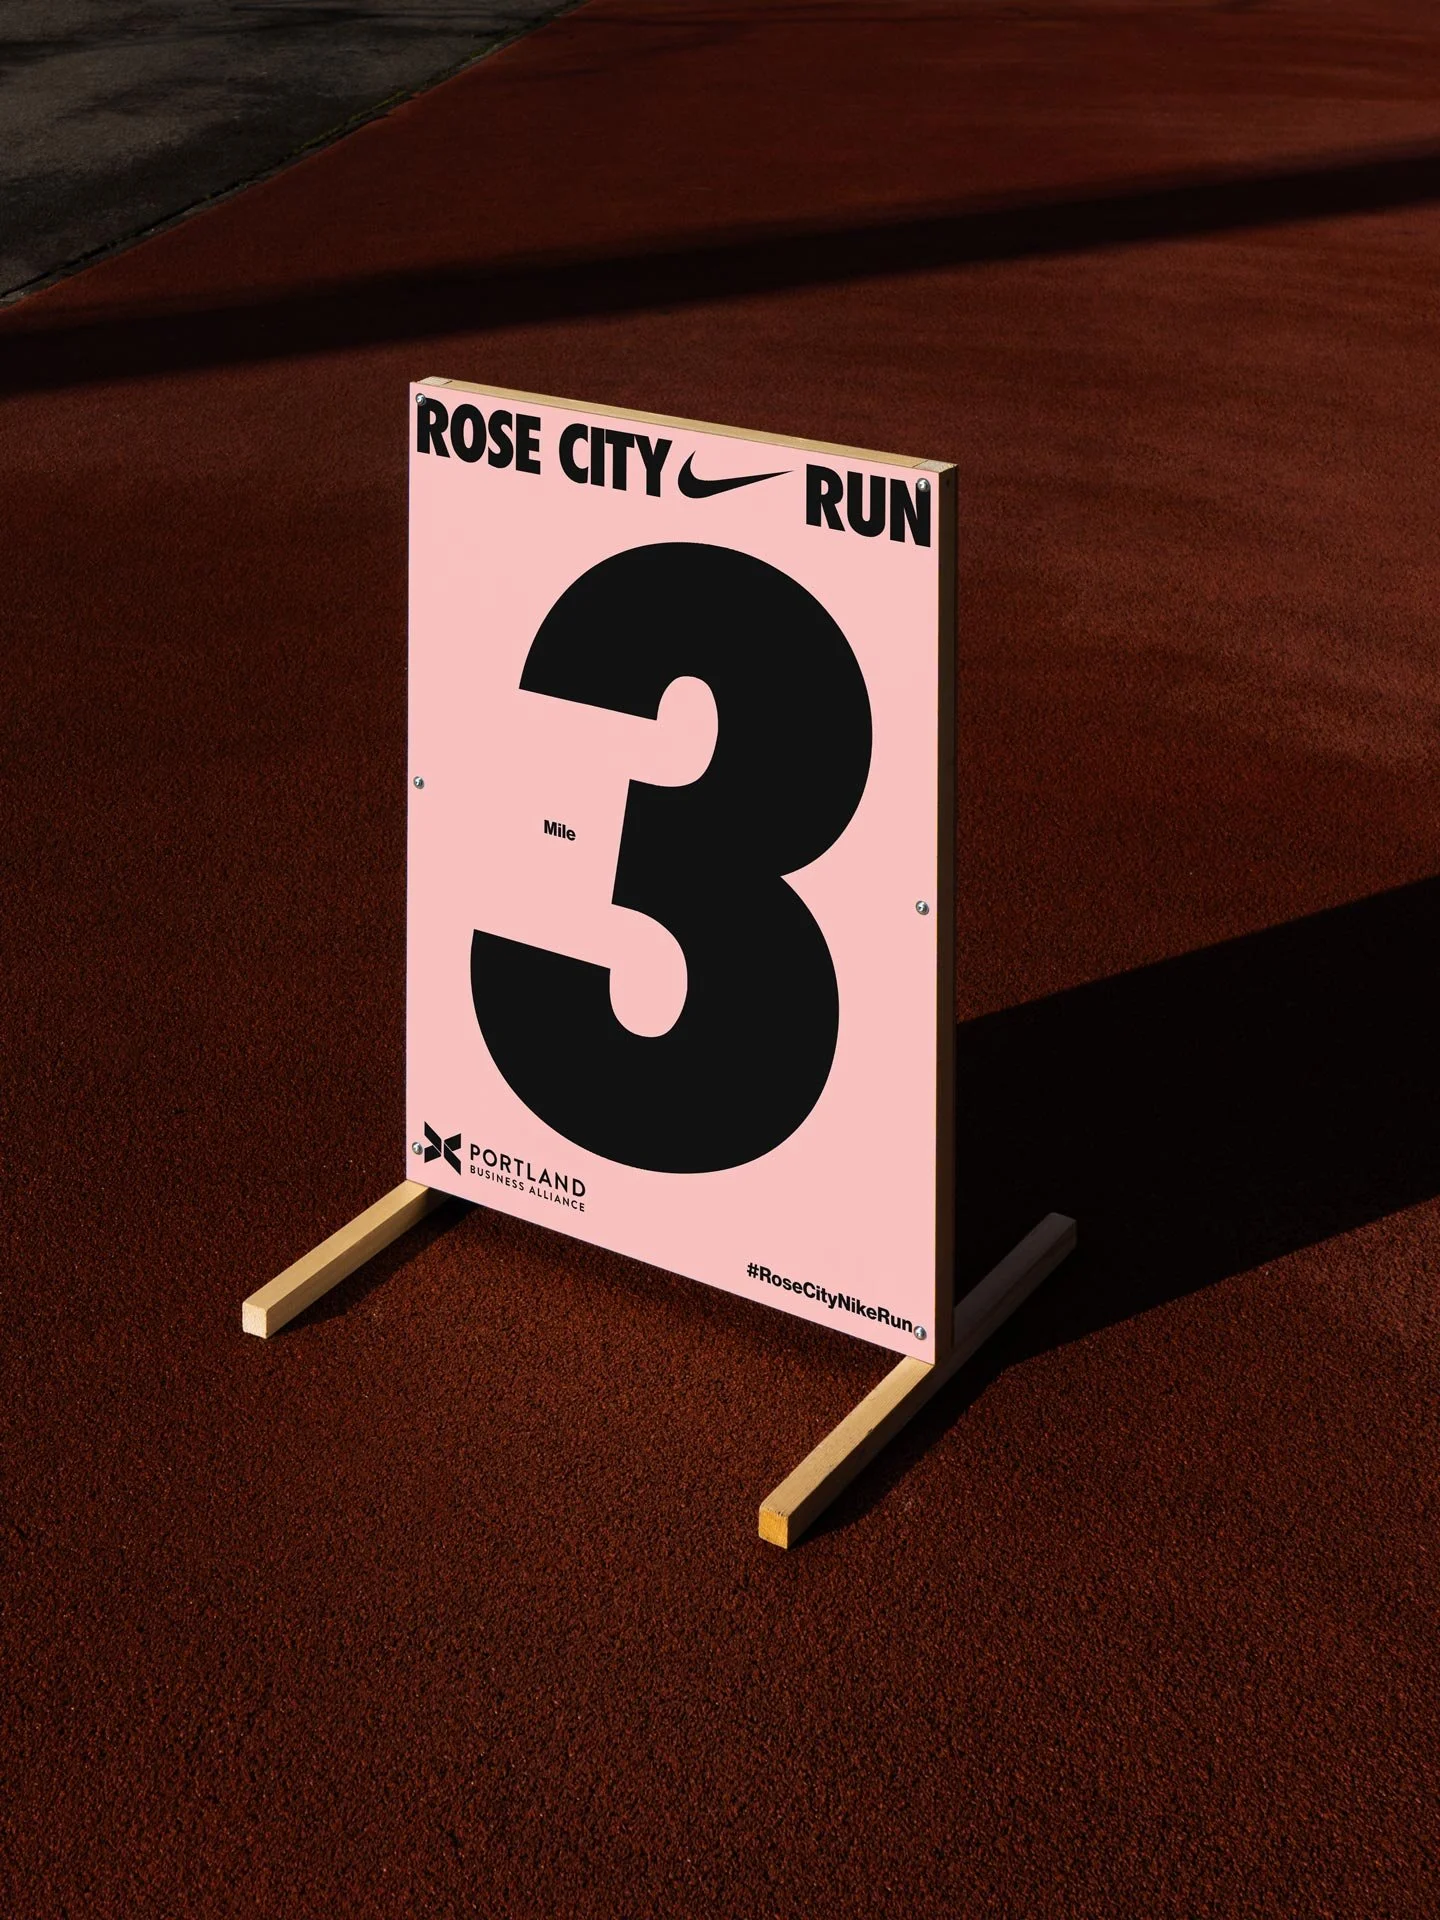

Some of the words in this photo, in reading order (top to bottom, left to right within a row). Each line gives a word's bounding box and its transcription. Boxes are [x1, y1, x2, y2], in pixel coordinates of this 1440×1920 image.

[416, 393, 542, 476] ROSE
[558, 422, 673, 498] CITY
[805, 463, 932, 548] RUN
[470, 541, 873, 1175] 3
[543, 819, 576, 842] Mile
[470, 1143, 587, 1198] PORTLAND
[470, 1164, 525, 1191] BUSINESS
[528, 1185, 586, 1213] ALLIANCE
[746, 1262, 913, 1334] #RoseCityNikeRun
